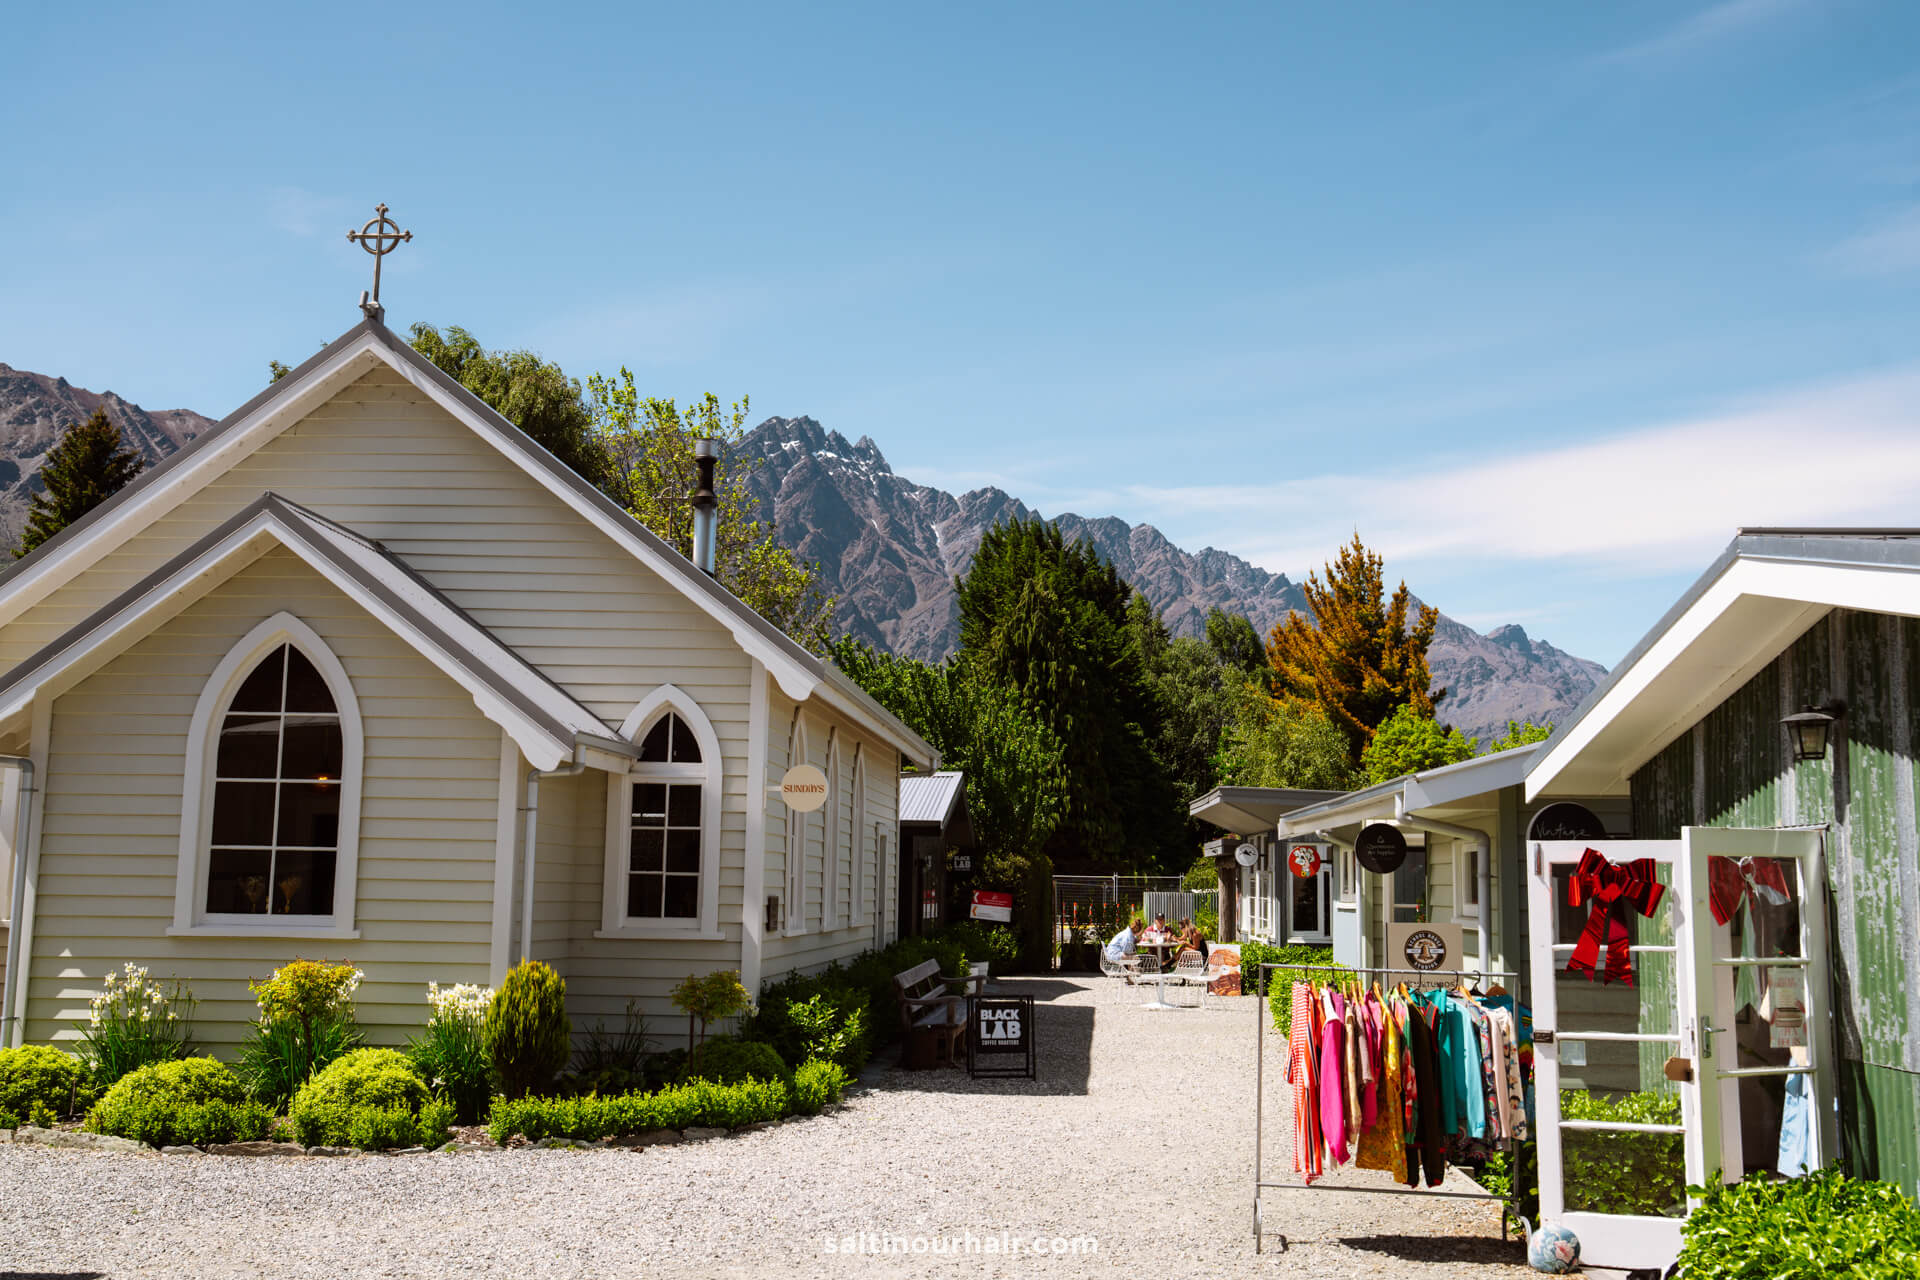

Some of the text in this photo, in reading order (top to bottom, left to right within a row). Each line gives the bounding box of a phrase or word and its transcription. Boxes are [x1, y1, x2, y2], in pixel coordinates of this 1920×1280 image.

[783, 784, 825, 793] SUNDAYS
[954, 860, 971, 868] LAB
[980, 1009, 1020, 1020] BLACK
[980, 1021, 1021, 1039] LAB
